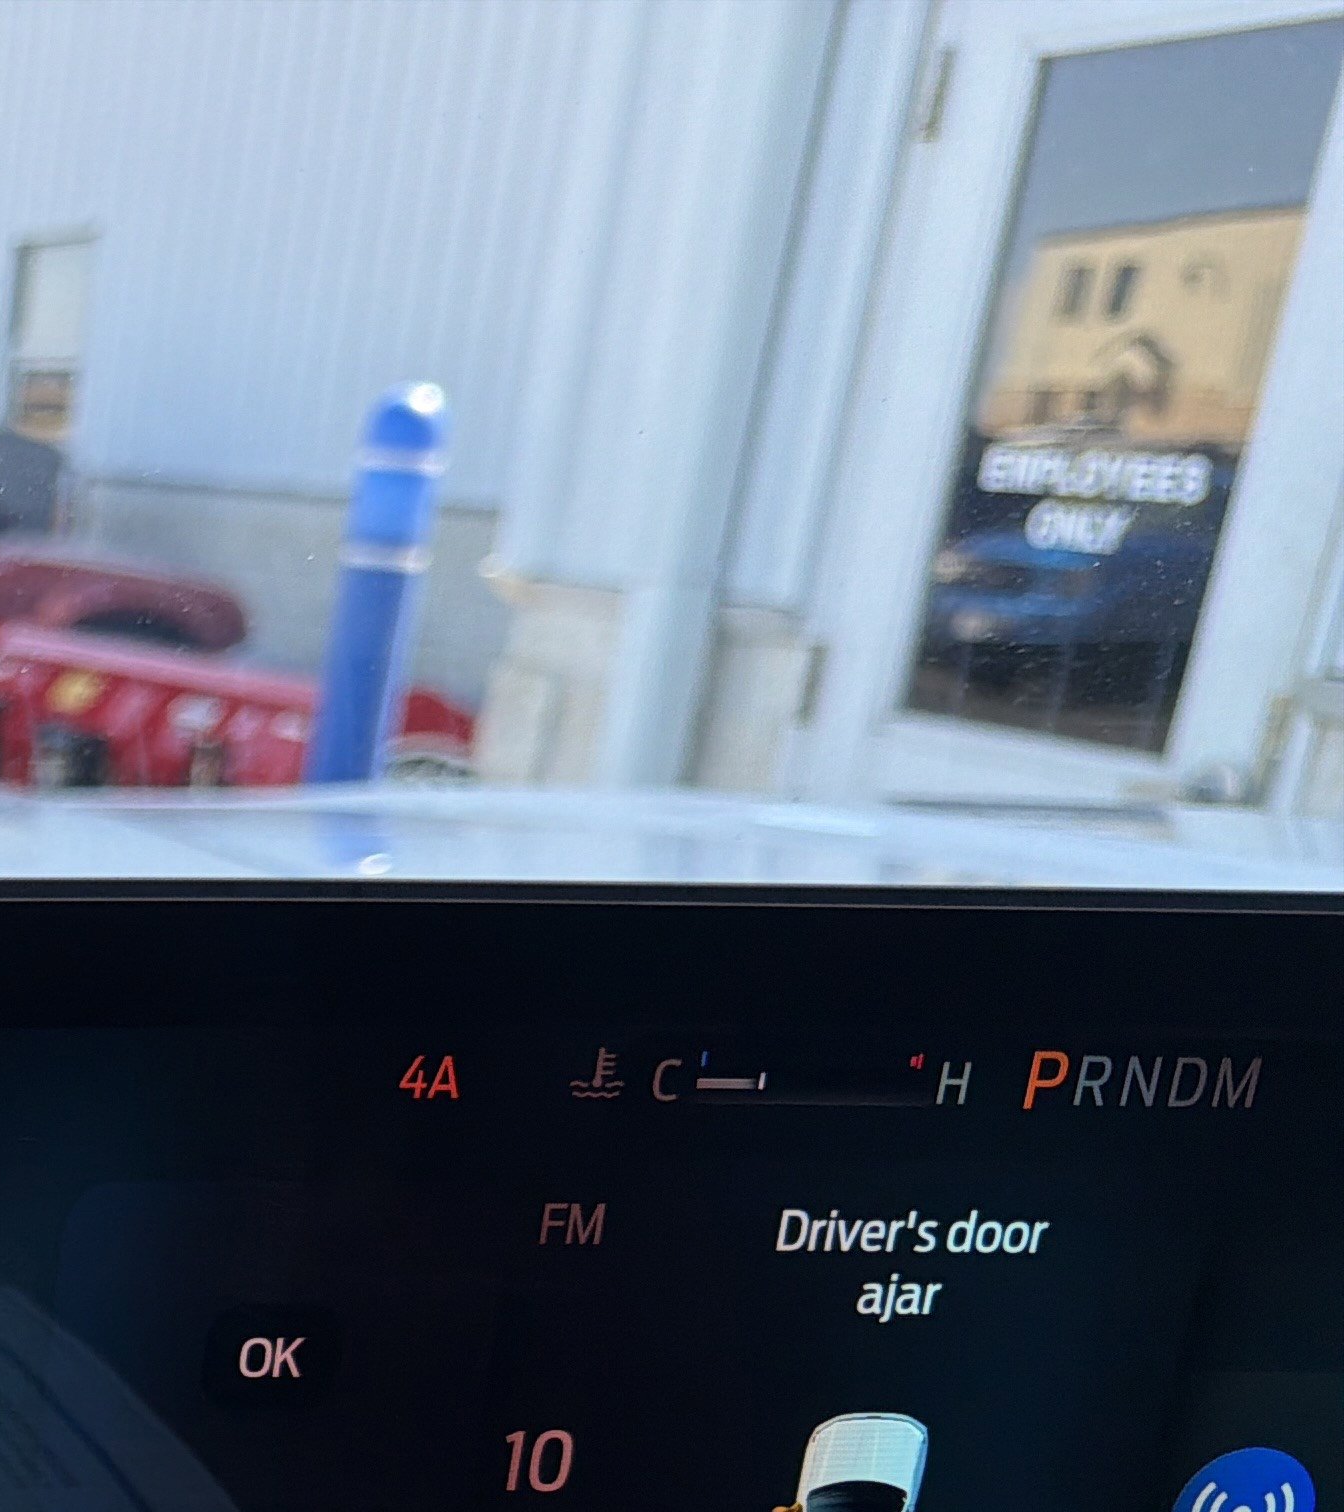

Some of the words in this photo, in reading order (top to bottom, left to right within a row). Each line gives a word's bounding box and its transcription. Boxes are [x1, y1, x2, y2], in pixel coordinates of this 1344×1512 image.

[399, 1055, 459, 1101] 4A
[652, 1060, 680, 1102] C
[936, 1061, 971, 1106] H
[538, 1204, 605, 1246] FM
[776, 1210, 938, 1254] Driver's
[945, 1210, 1049, 1254] door
[857, 1276, 940, 1322] ajar
[239, 1336, 306, 1379] OK
[505, 1429, 574, 1493] 10
